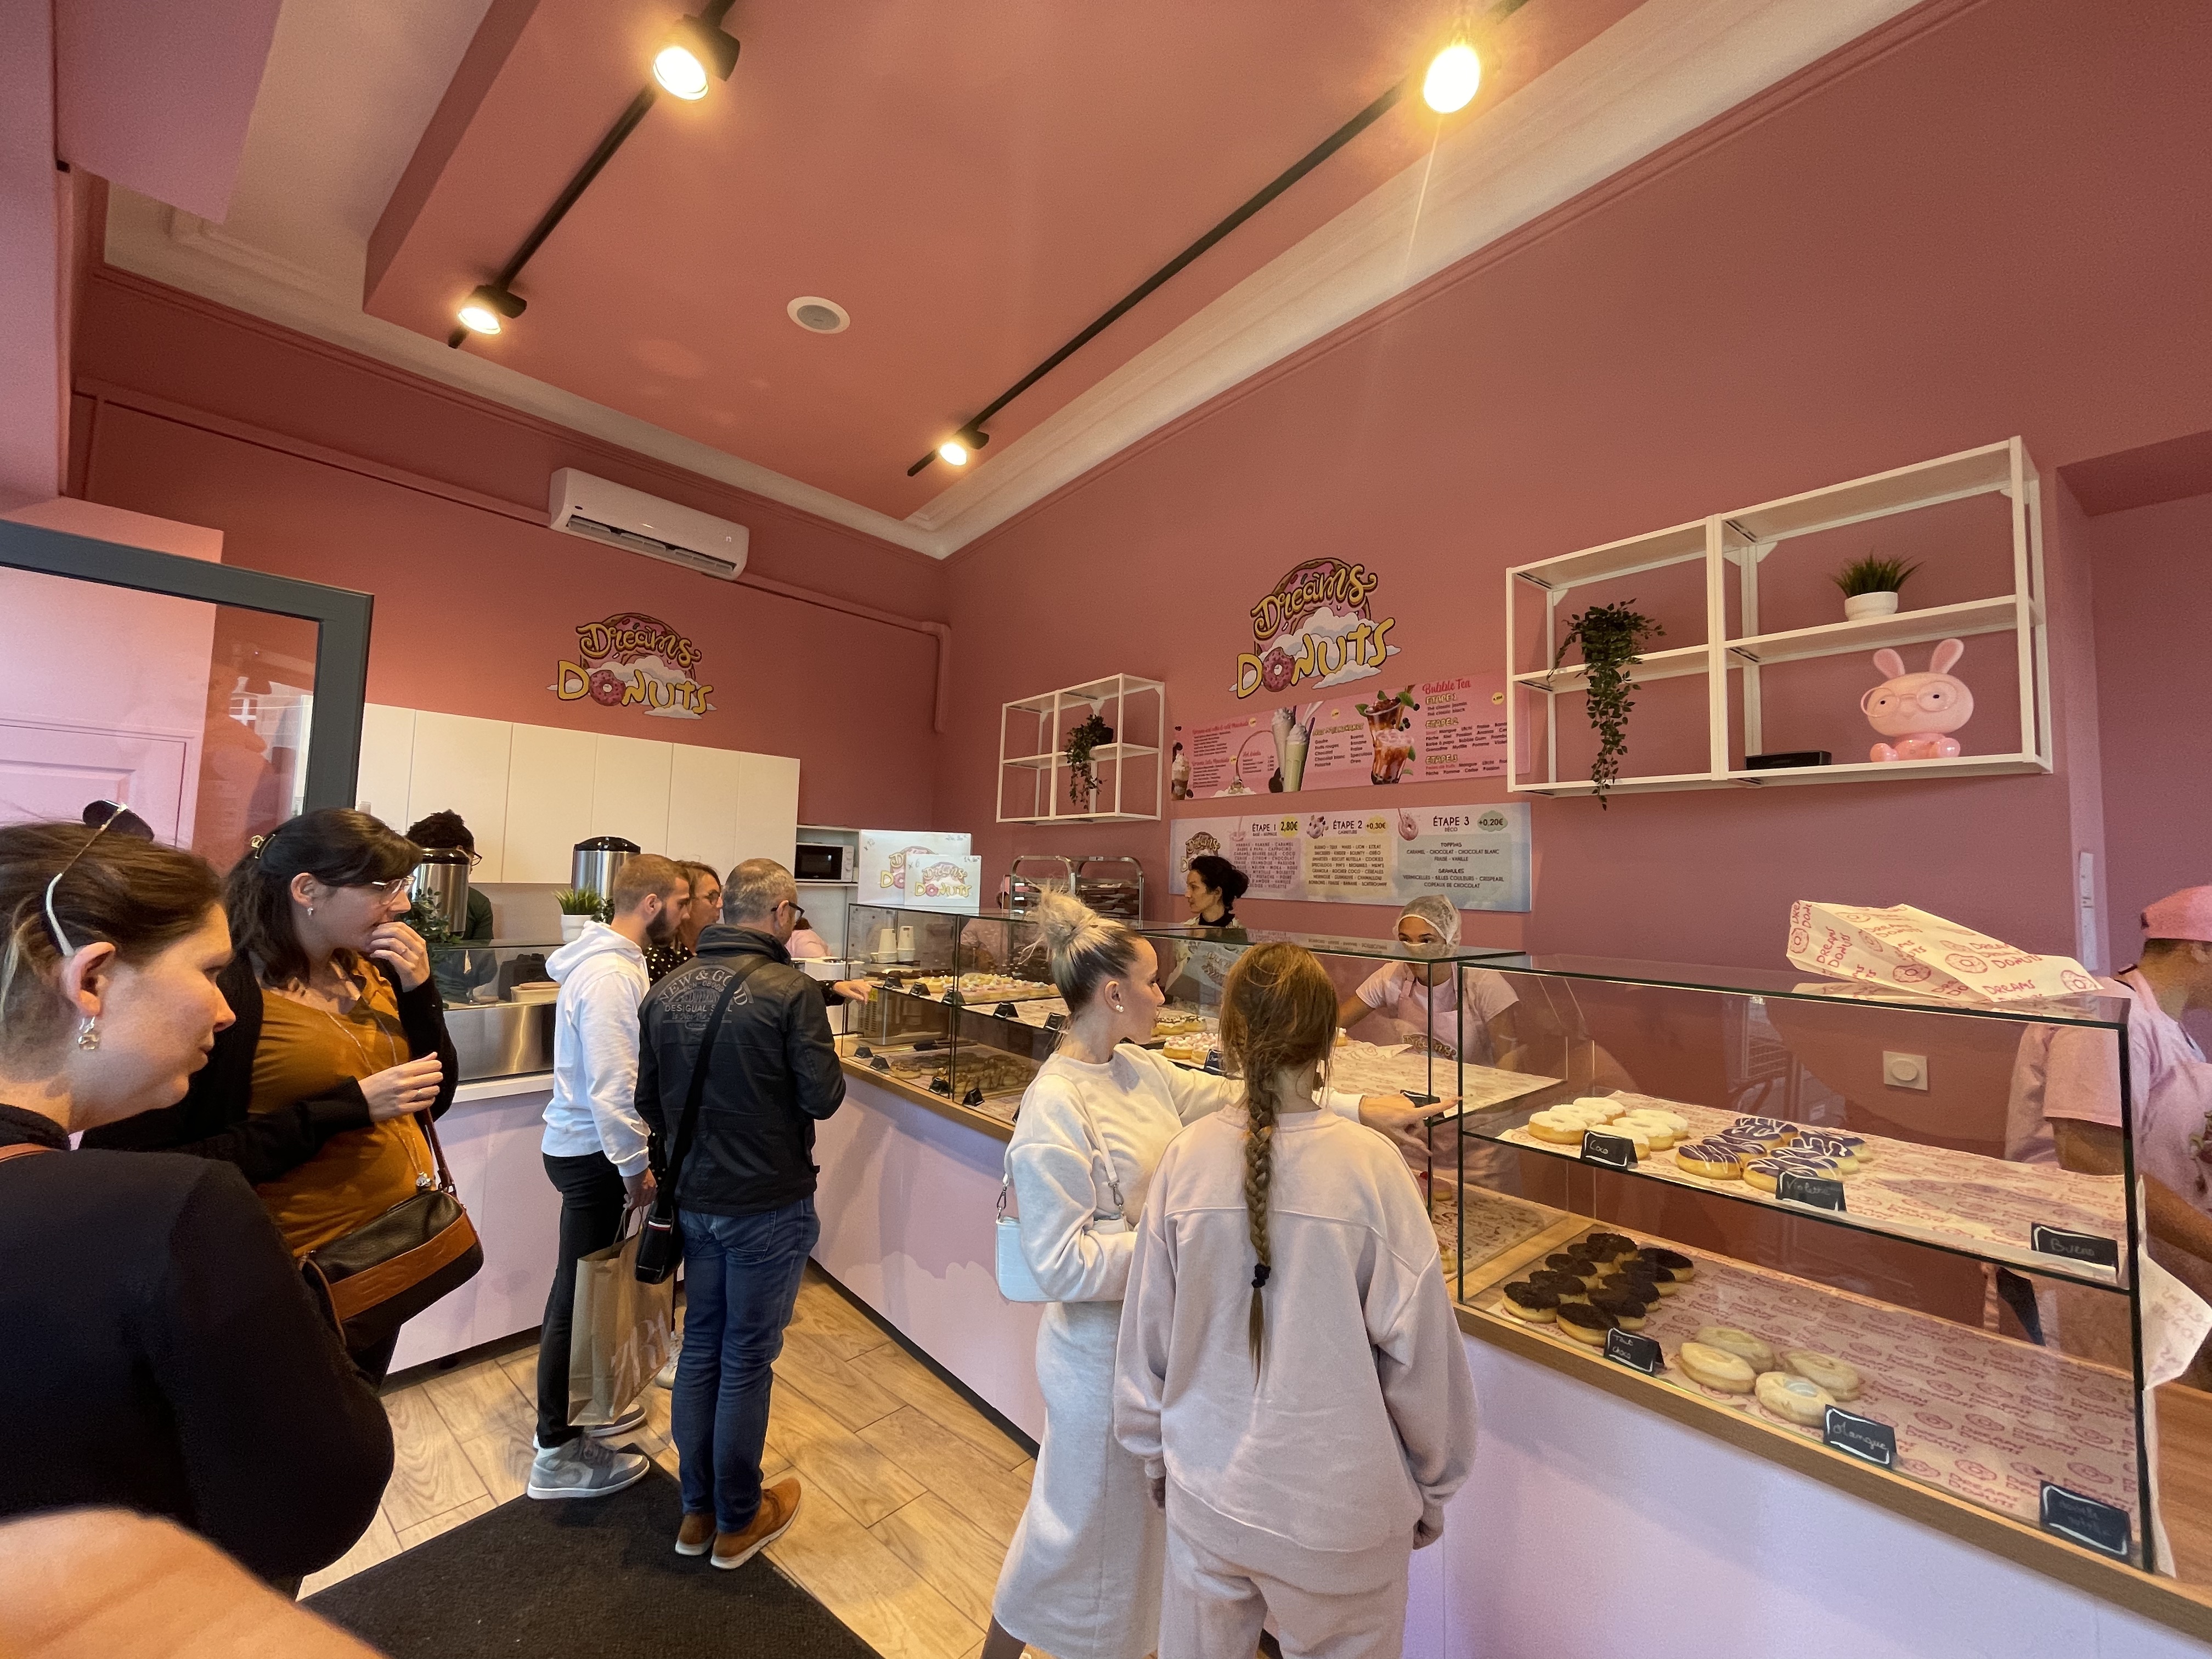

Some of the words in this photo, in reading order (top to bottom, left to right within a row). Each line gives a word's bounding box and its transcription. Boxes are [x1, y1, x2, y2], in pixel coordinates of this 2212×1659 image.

[1250, 563, 1378, 641] Dreams
[576, 622, 702, 668] Dreams
[1237, 617, 1396, 699] DONUTS
[557, 660, 713, 714] DONUTS
[1422, 680, 1454, 695] Bubble
[1455, 678, 1471, 690] Tea
[1426, 693, 1452, 705] ETAPE
[1453, 693, 1457, 701] 1
[1425, 718, 1452, 729] ETAPE
[1425, 754, 1452, 764] ETAPE
[1453, 754, 1458, 762] 3
[1252, 823, 1270, 832] ÉTAPE
[1280, 821, 1298, 832] 2,80€
[1333, 820, 1355, 830] ÉTAPE
[1358, 820, 1362, 829] 2
[1433, 816, 1460, 826] ÉTAPE
[1464, 816, 1470, 826] 3
[922, 866, 968, 880] Dreams
[915, 881, 972, 897] DONUTS
[659, 973, 692, 1005] NEW
[696, 970, 708, 981] &
[2051, 1238, 2095, 1256] Bueno
